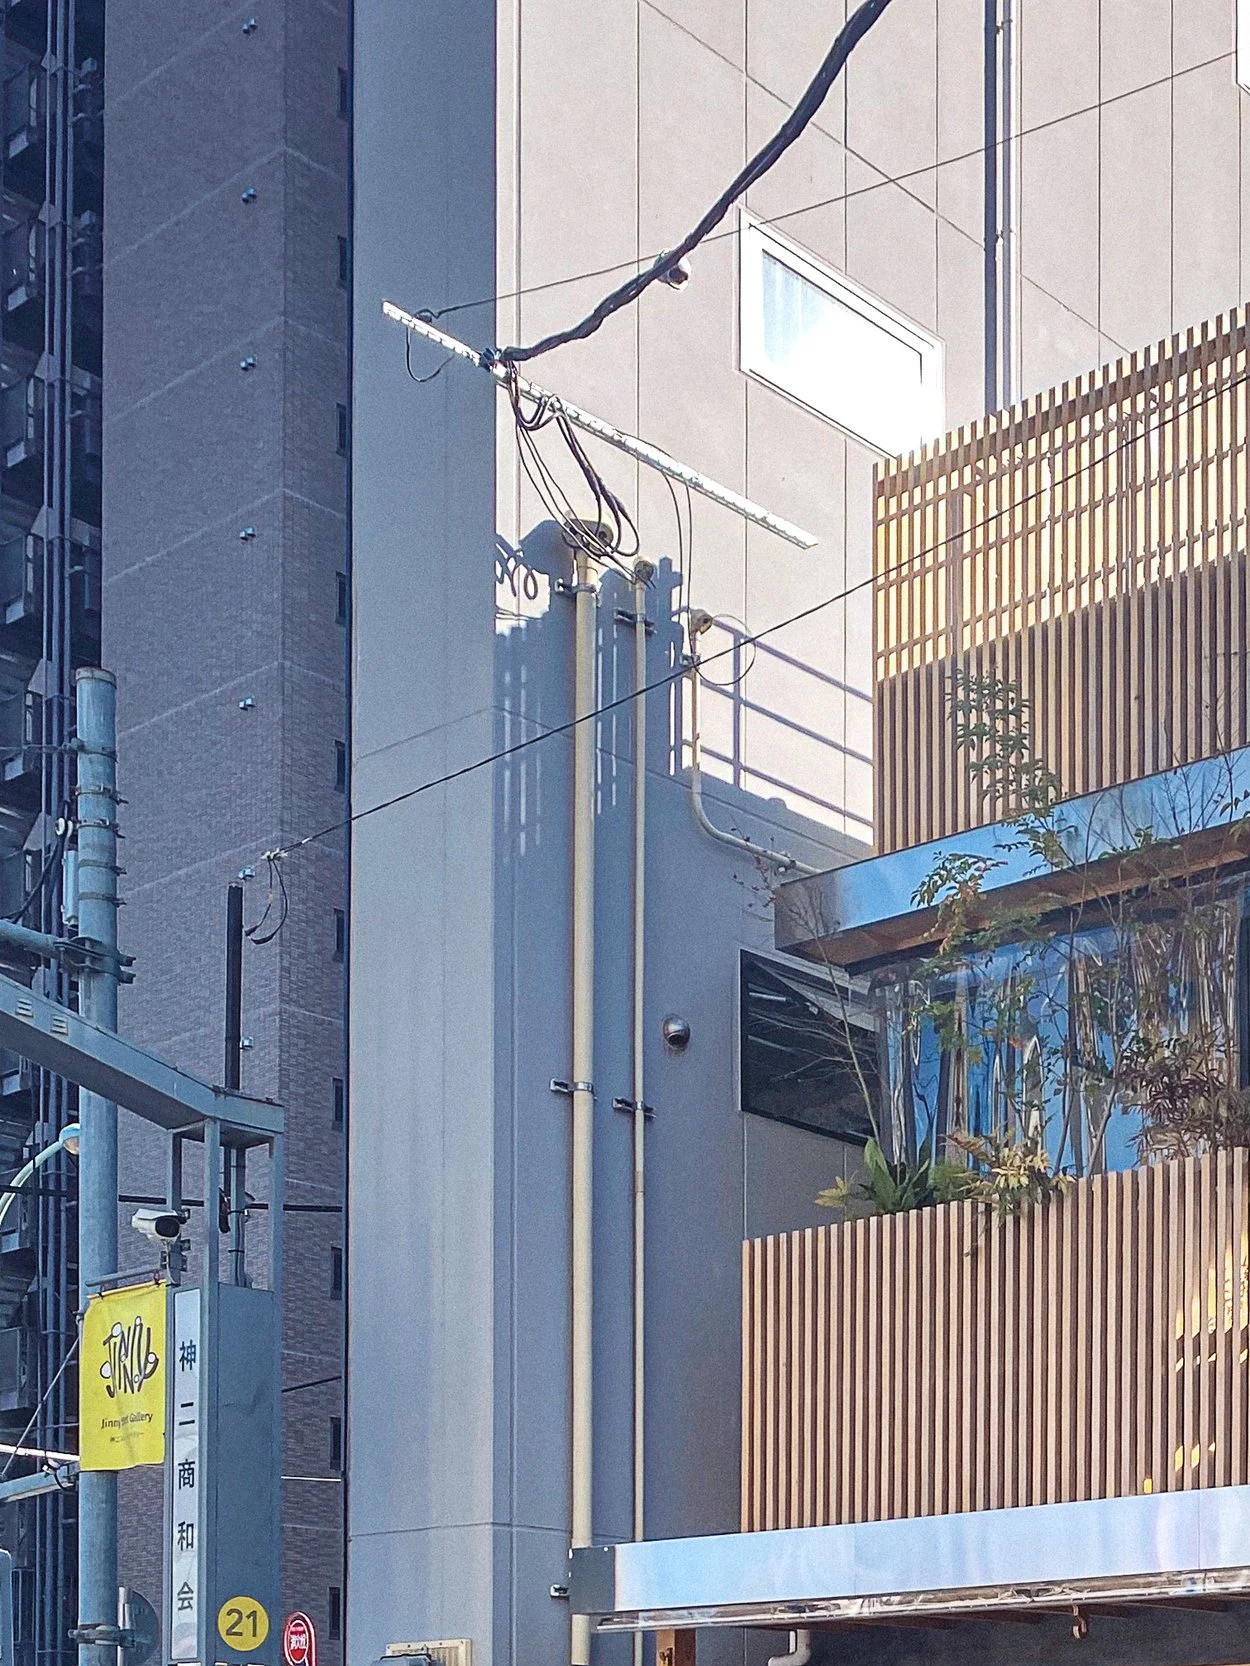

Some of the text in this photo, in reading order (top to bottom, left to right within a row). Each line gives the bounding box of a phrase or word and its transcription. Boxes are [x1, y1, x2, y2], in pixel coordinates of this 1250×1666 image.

[177, 1339, 197, 1611] 神二商和会
[225, 1608, 258, 1638] 21
